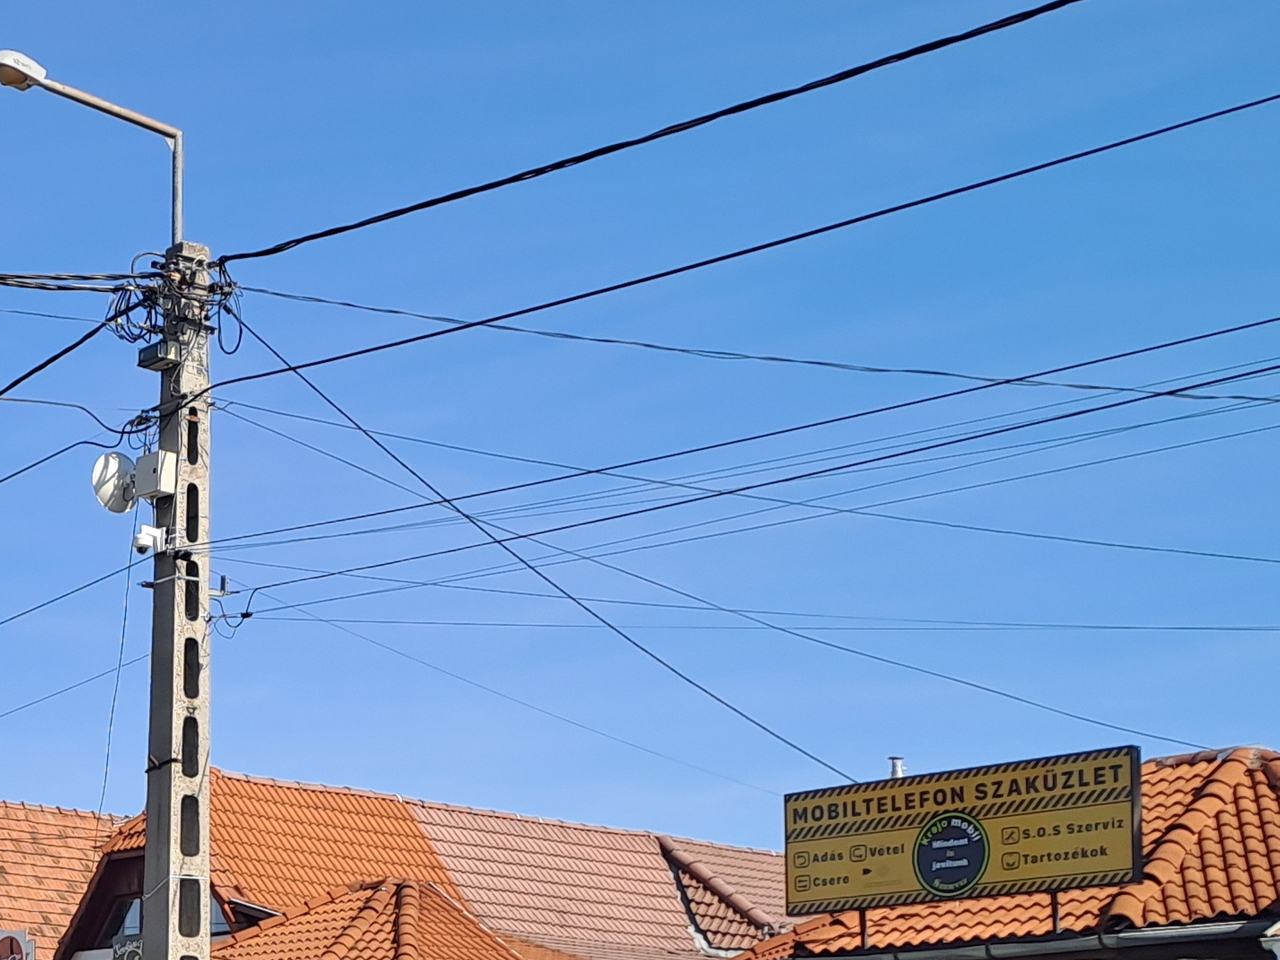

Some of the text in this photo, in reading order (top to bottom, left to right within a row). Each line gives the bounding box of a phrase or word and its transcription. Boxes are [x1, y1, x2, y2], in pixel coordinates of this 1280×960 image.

[792, 763, 1124, 825] MOBILTELEFON SZAKÜZLET
[1022, 817, 1124, 840] S.O.S Szerviz
[812, 850, 844, 864] Adás
[869, 843, 905, 858] Vétel
[1022, 845, 1108, 865] Tartozékok
[813, 875, 850, 888] Csere
